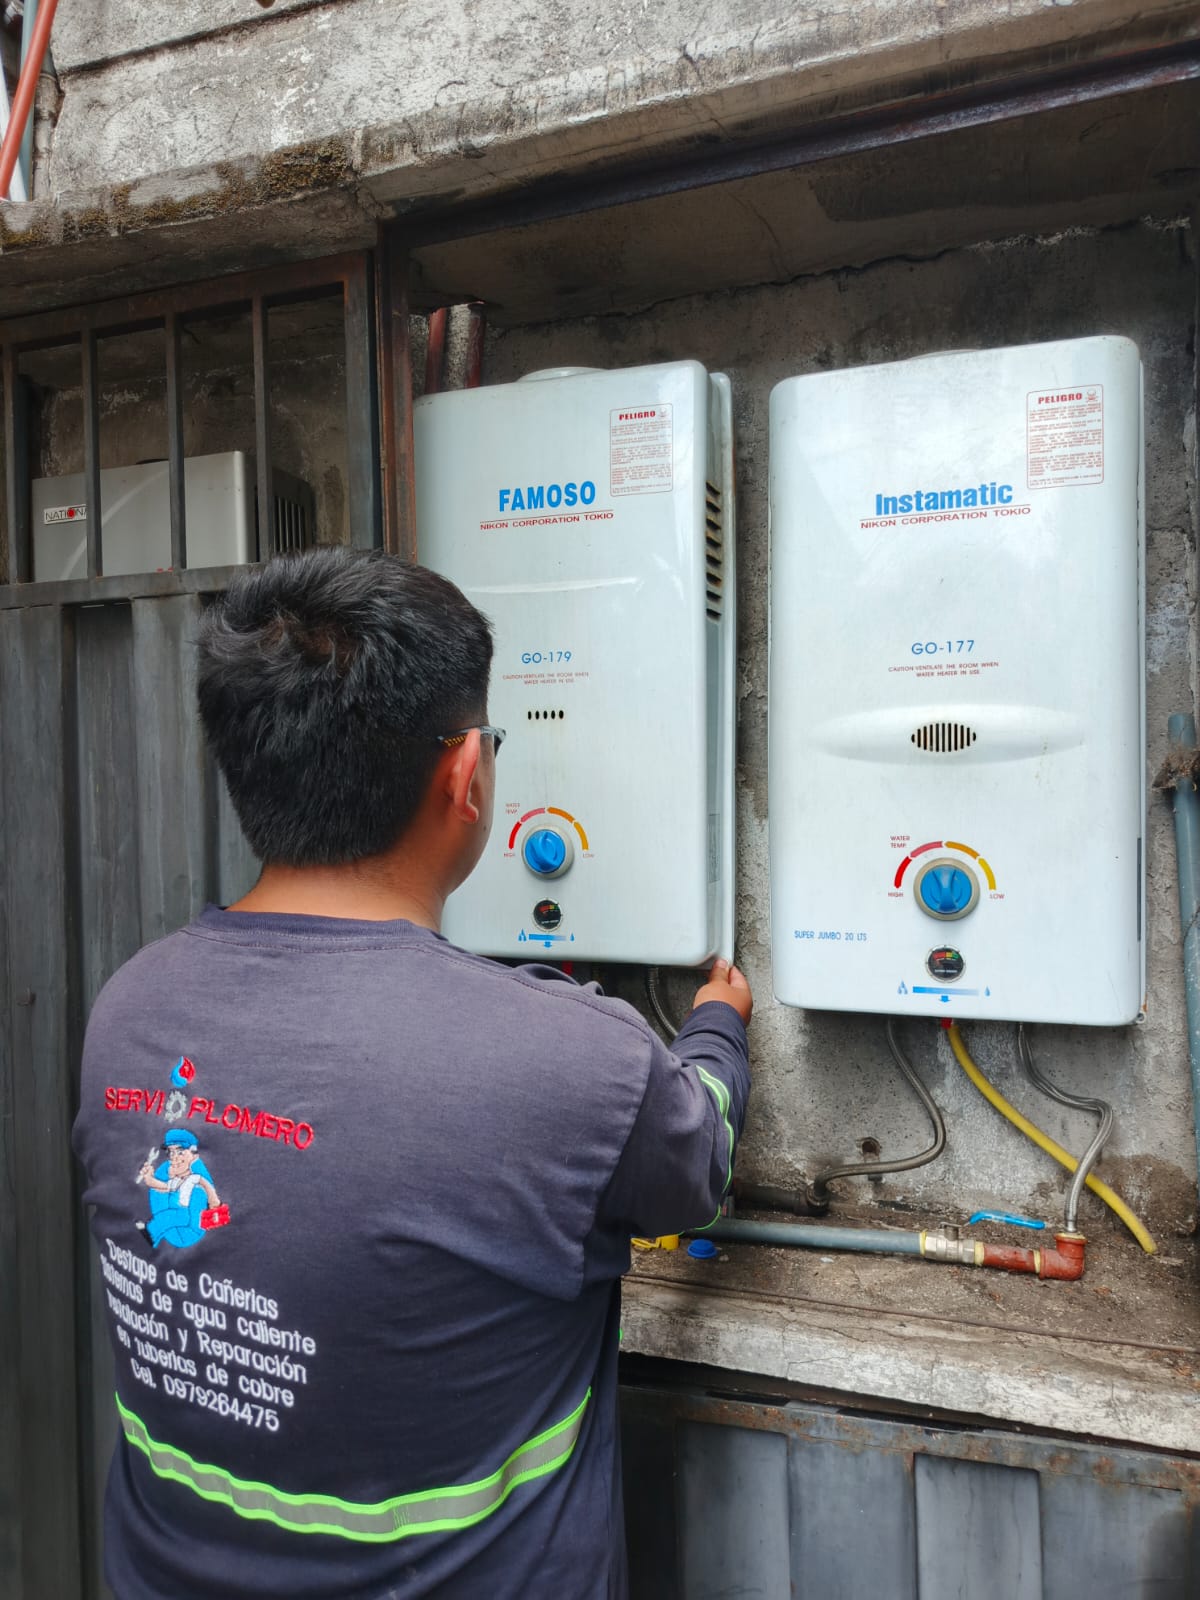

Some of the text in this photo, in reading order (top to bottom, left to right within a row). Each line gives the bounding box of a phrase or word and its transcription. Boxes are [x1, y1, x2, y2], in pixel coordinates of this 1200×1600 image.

[1038, 393, 1083, 404] PELIGRO
[618, 411, 656, 421] PELIGRO
[499, 481, 596, 512] FAMOSO
[876, 482, 1013, 516] Instamatic
[480, 512, 614, 530] NIKON CORPORATION TOKIO
[861, 507, 1031, 529] NIKON CORPORATION TOKIO
[521, 651, 572, 664] GO-179
[911, 639, 975, 655] GO-177
[794, 930, 815, 940] SUPER
[817, 932, 842, 941] JUMBO
[844, 934, 855, 942] 20
[104, 1087, 315, 1151] SERVI PLOMERO
[105, 1237, 157, 1284] Destape
[165, 1269, 189, 1293] de
[151, 1289, 173, 1313] de
[183, 1301, 227, 1330] agua
[237, 1316, 317, 1355] caliente
[116, 1325, 131, 1348] en
[206, 1363, 229, 1386] de
[238, 1375, 295, 1408] cobre
[177, 1328, 188, 1352] y
[197, 1331, 308, 1384] Reparación
[130, 1358, 280, 1431] Cel. 0979264475
